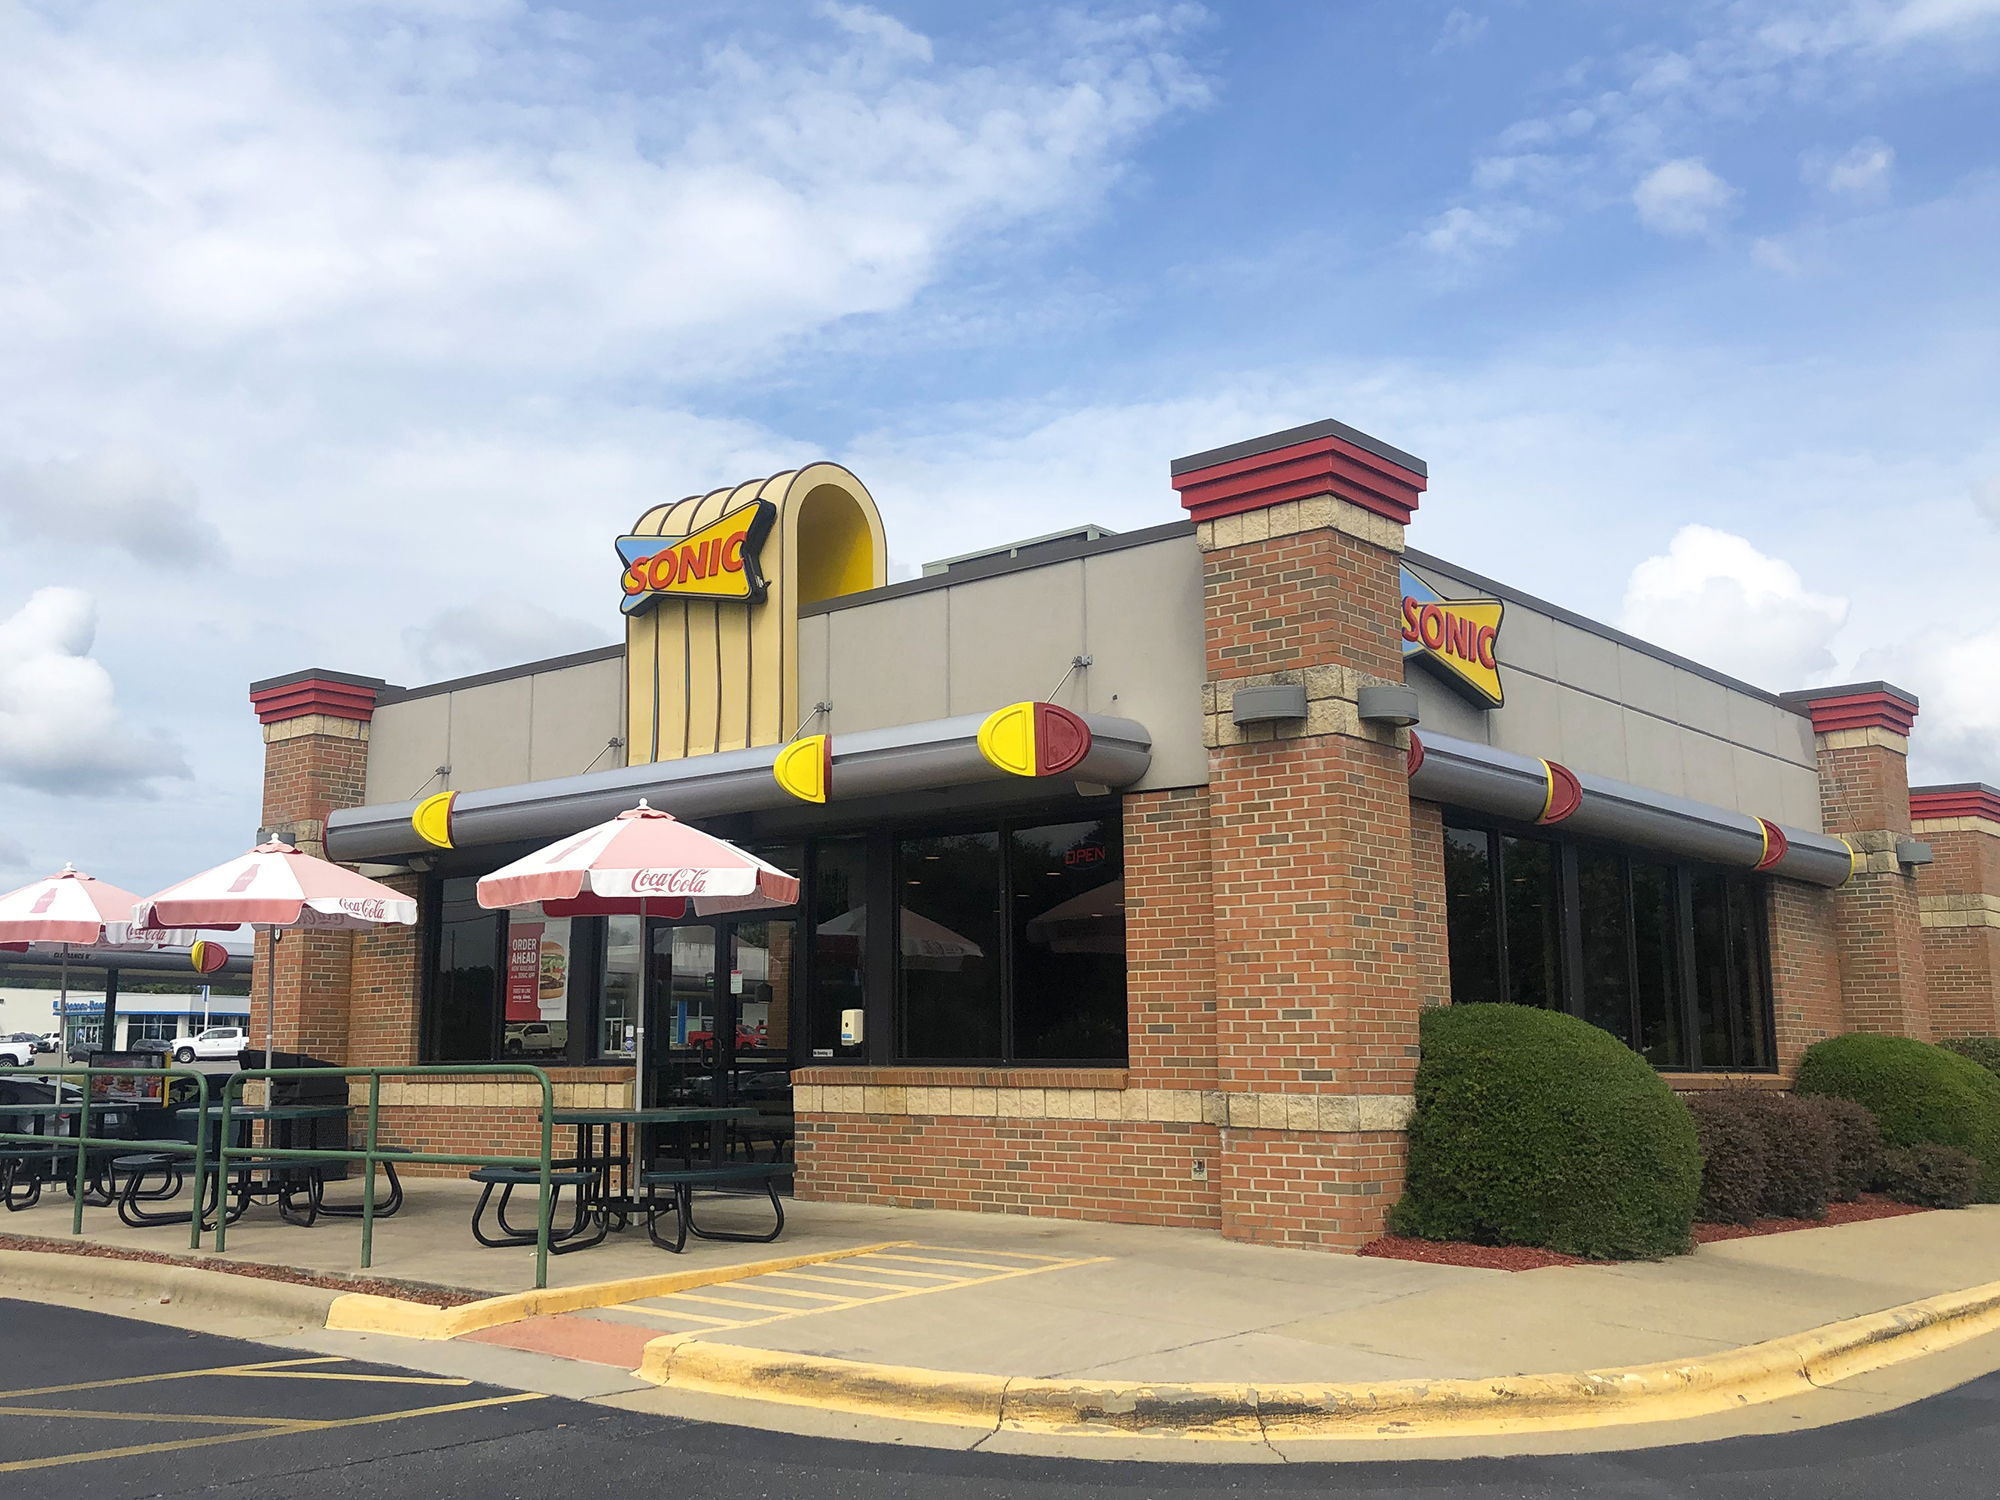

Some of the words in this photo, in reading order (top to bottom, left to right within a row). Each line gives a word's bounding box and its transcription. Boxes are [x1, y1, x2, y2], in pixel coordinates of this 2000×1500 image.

[626, 531, 747, 596] SONIC
[1402, 596, 1495, 670] SONIC
[1065, 845, 1106, 865] OPEN
[631, 868, 710, 893] Coca-Cola
[339, 898, 386, 919] Coca-Cola
[126, 922, 167, 940] CocaCola
[512, 938, 537, 951] ORDER
[511, 952, 537, 965] AHEAD
